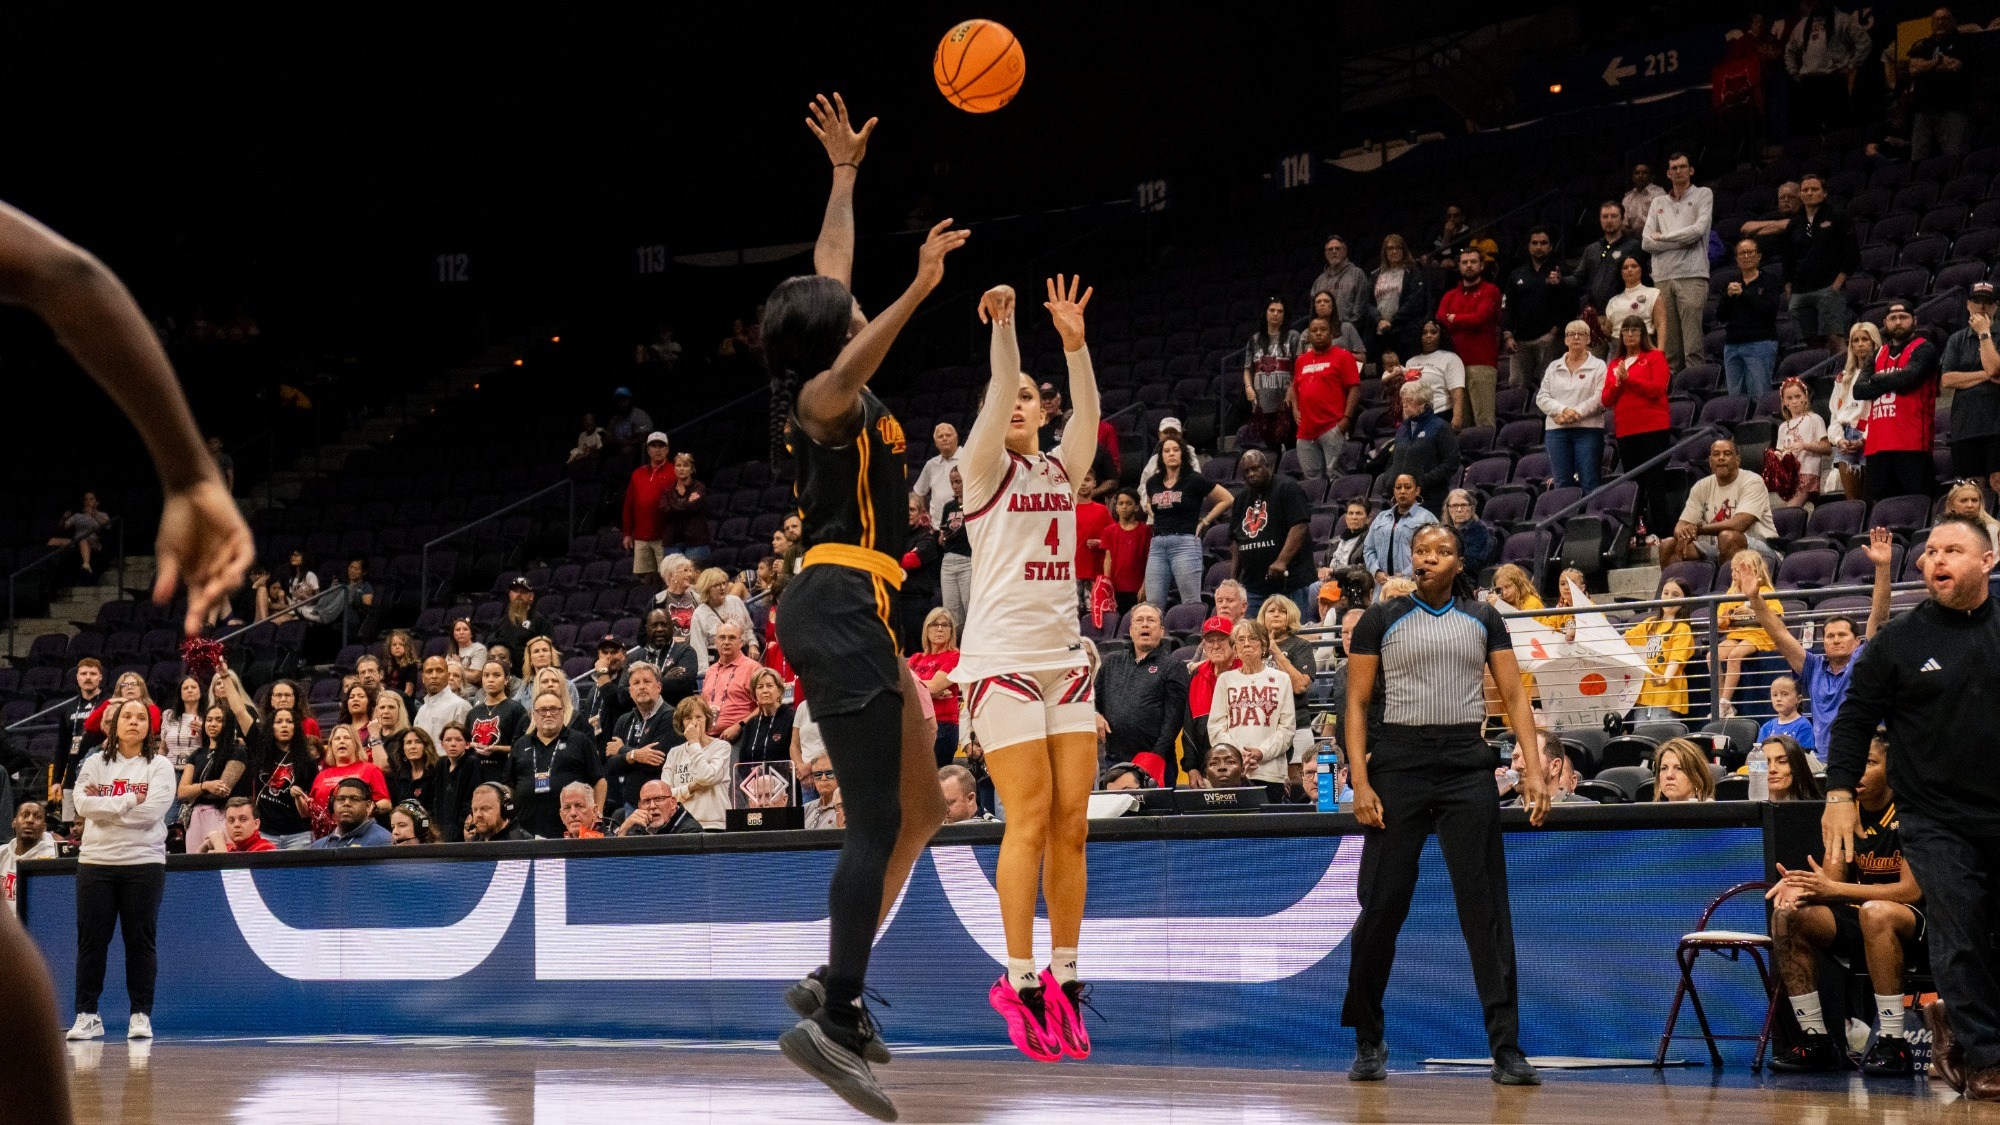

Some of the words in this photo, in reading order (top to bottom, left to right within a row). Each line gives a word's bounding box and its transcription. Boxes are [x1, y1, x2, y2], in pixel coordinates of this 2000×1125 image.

[1644, 49, 1679, 76] 213
[1282, 152, 1310, 188] 114
[1137, 179, 1166, 212] 113
[436, 253, 469, 282] 112
[636, 244, 666, 274] 113
[1006, 492, 1074, 512] ARKANSA
[1044, 517, 1060, 556] 4
[1240, 539, 1276, 551] SKETBALL
[1024, 561, 1071, 581] STATE
[1227, 685, 1280, 705] GAME
[1228, 703, 1279, 729] DAY
